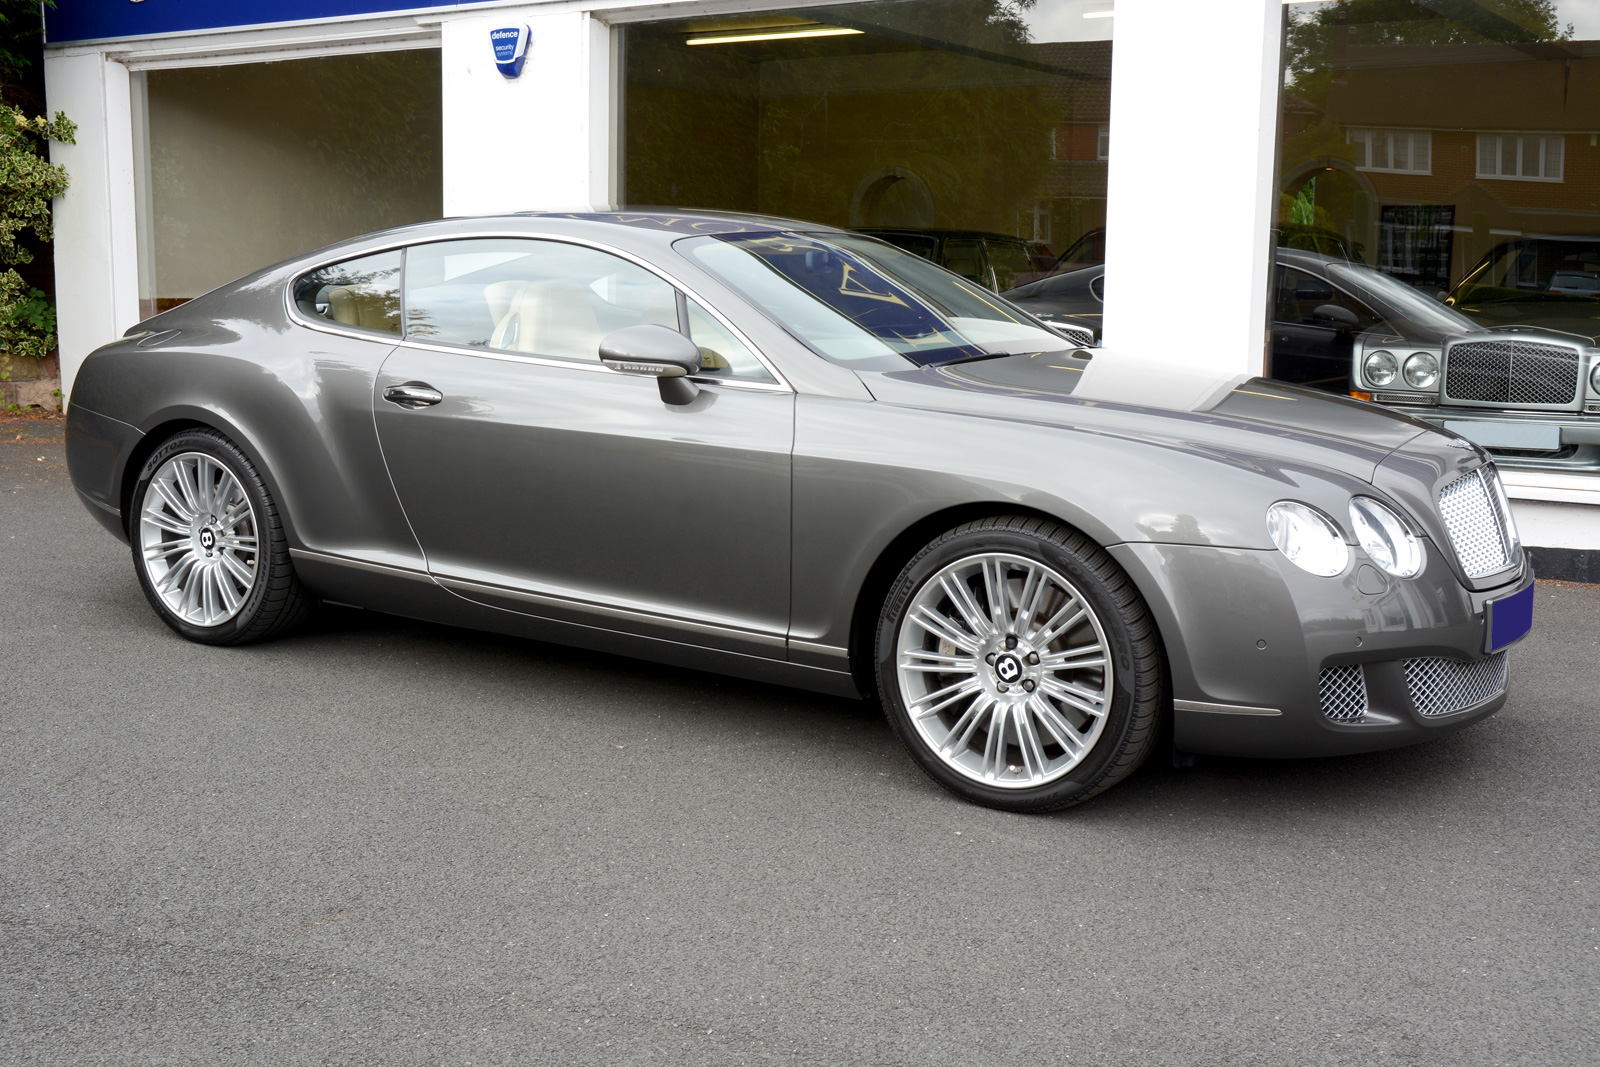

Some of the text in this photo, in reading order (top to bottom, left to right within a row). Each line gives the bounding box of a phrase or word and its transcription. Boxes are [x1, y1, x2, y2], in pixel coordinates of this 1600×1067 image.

[491, 31, 518, 39] defence
[495, 44, 515, 52] security
[885, 575, 915, 624] PIRELLI
[998, 657, 1019, 680] B
